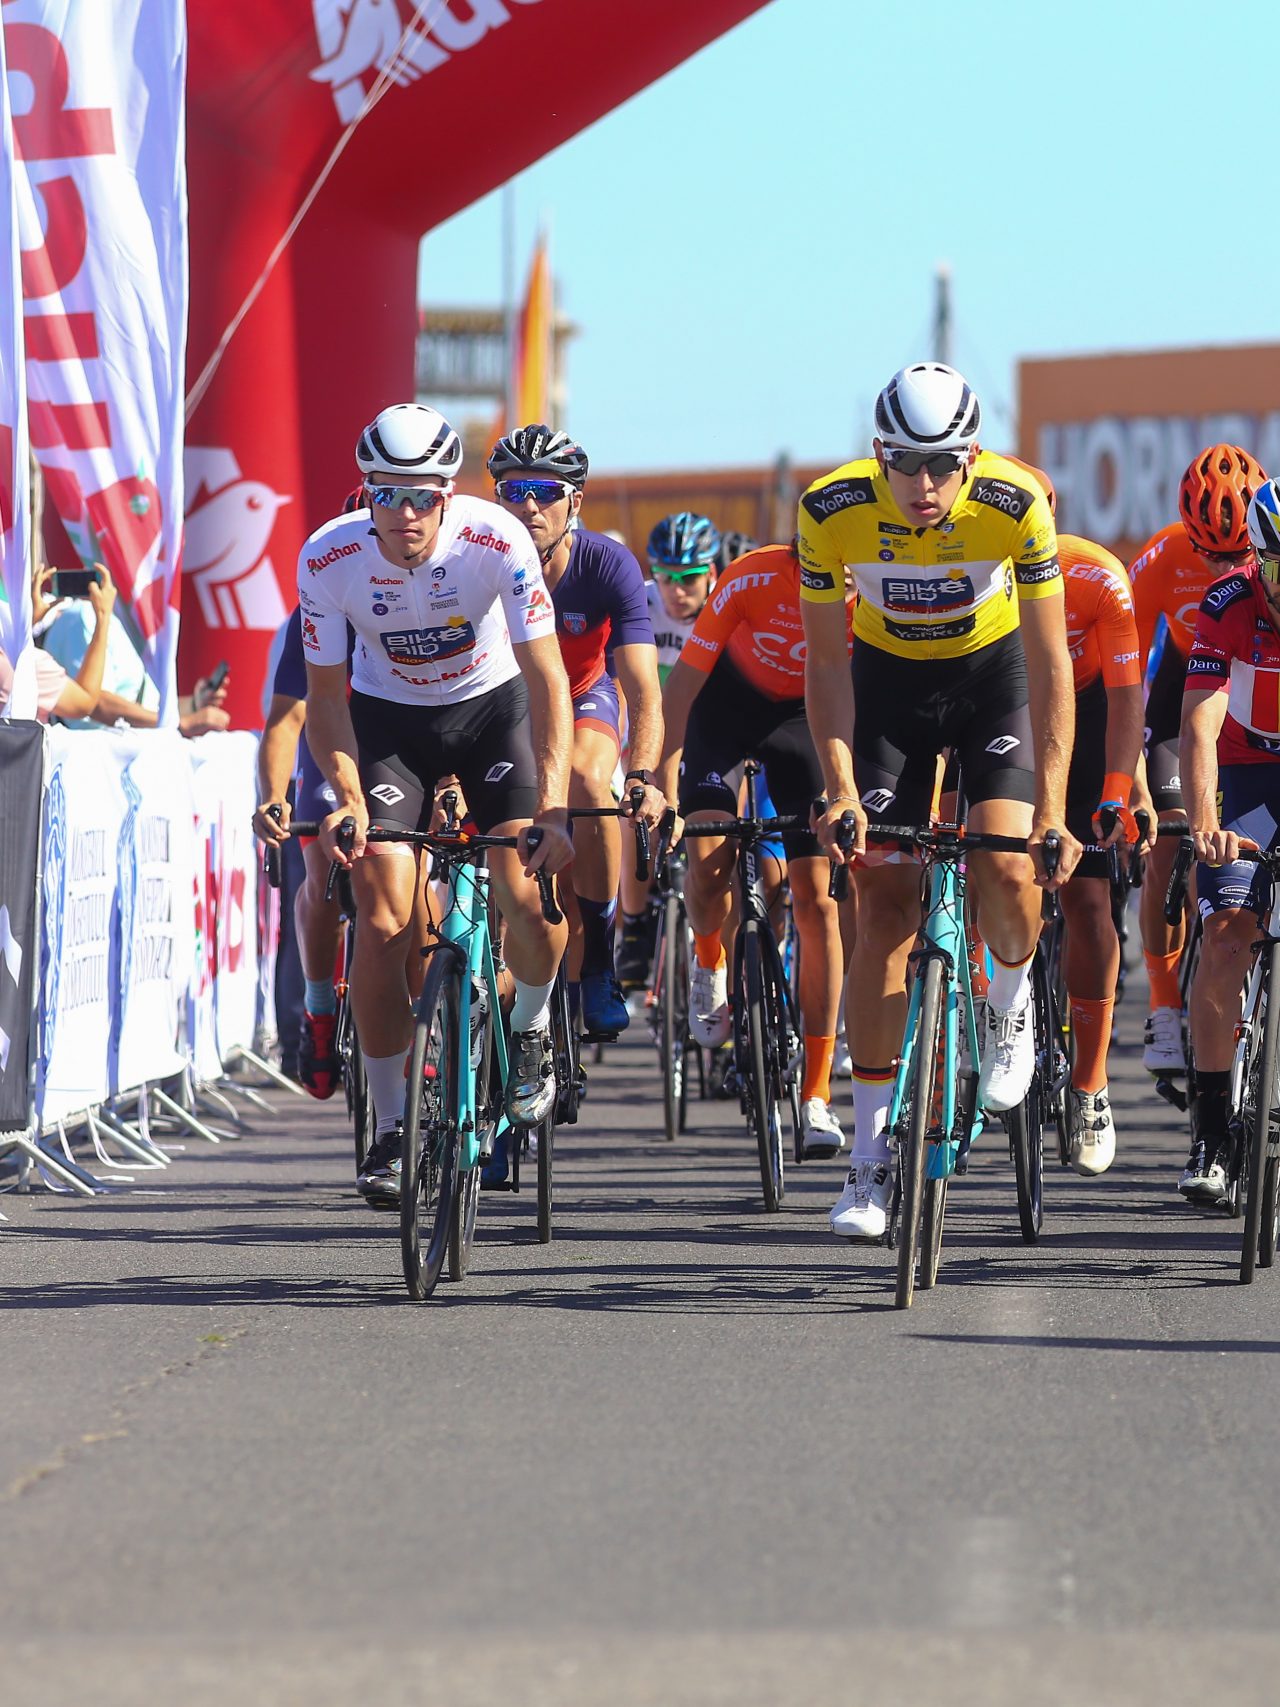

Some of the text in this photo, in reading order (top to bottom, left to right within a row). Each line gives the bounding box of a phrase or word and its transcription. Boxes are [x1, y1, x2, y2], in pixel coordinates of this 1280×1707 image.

[823, 482, 849, 495] DANONE
[991, 480, 1016, 494] DANONE
[814, 489, 867, 515] YoPRO
[976, 486, 1021, 515] YoPRO
[457, 526, 512, 555] Auchan
[307, 542, 362, 577] Auchan
[369, 576, 404, 585] Auchan
[800, 575, 825, 589] PRO
[1020, 564, 1060, 582] YoPRO
[711, 572, 779, 616] GIANT
[1206, 579, 1243, 607] Dare
[769, 618, 803, 631] CADE
[1187, 657, 1221, 672] Dare
